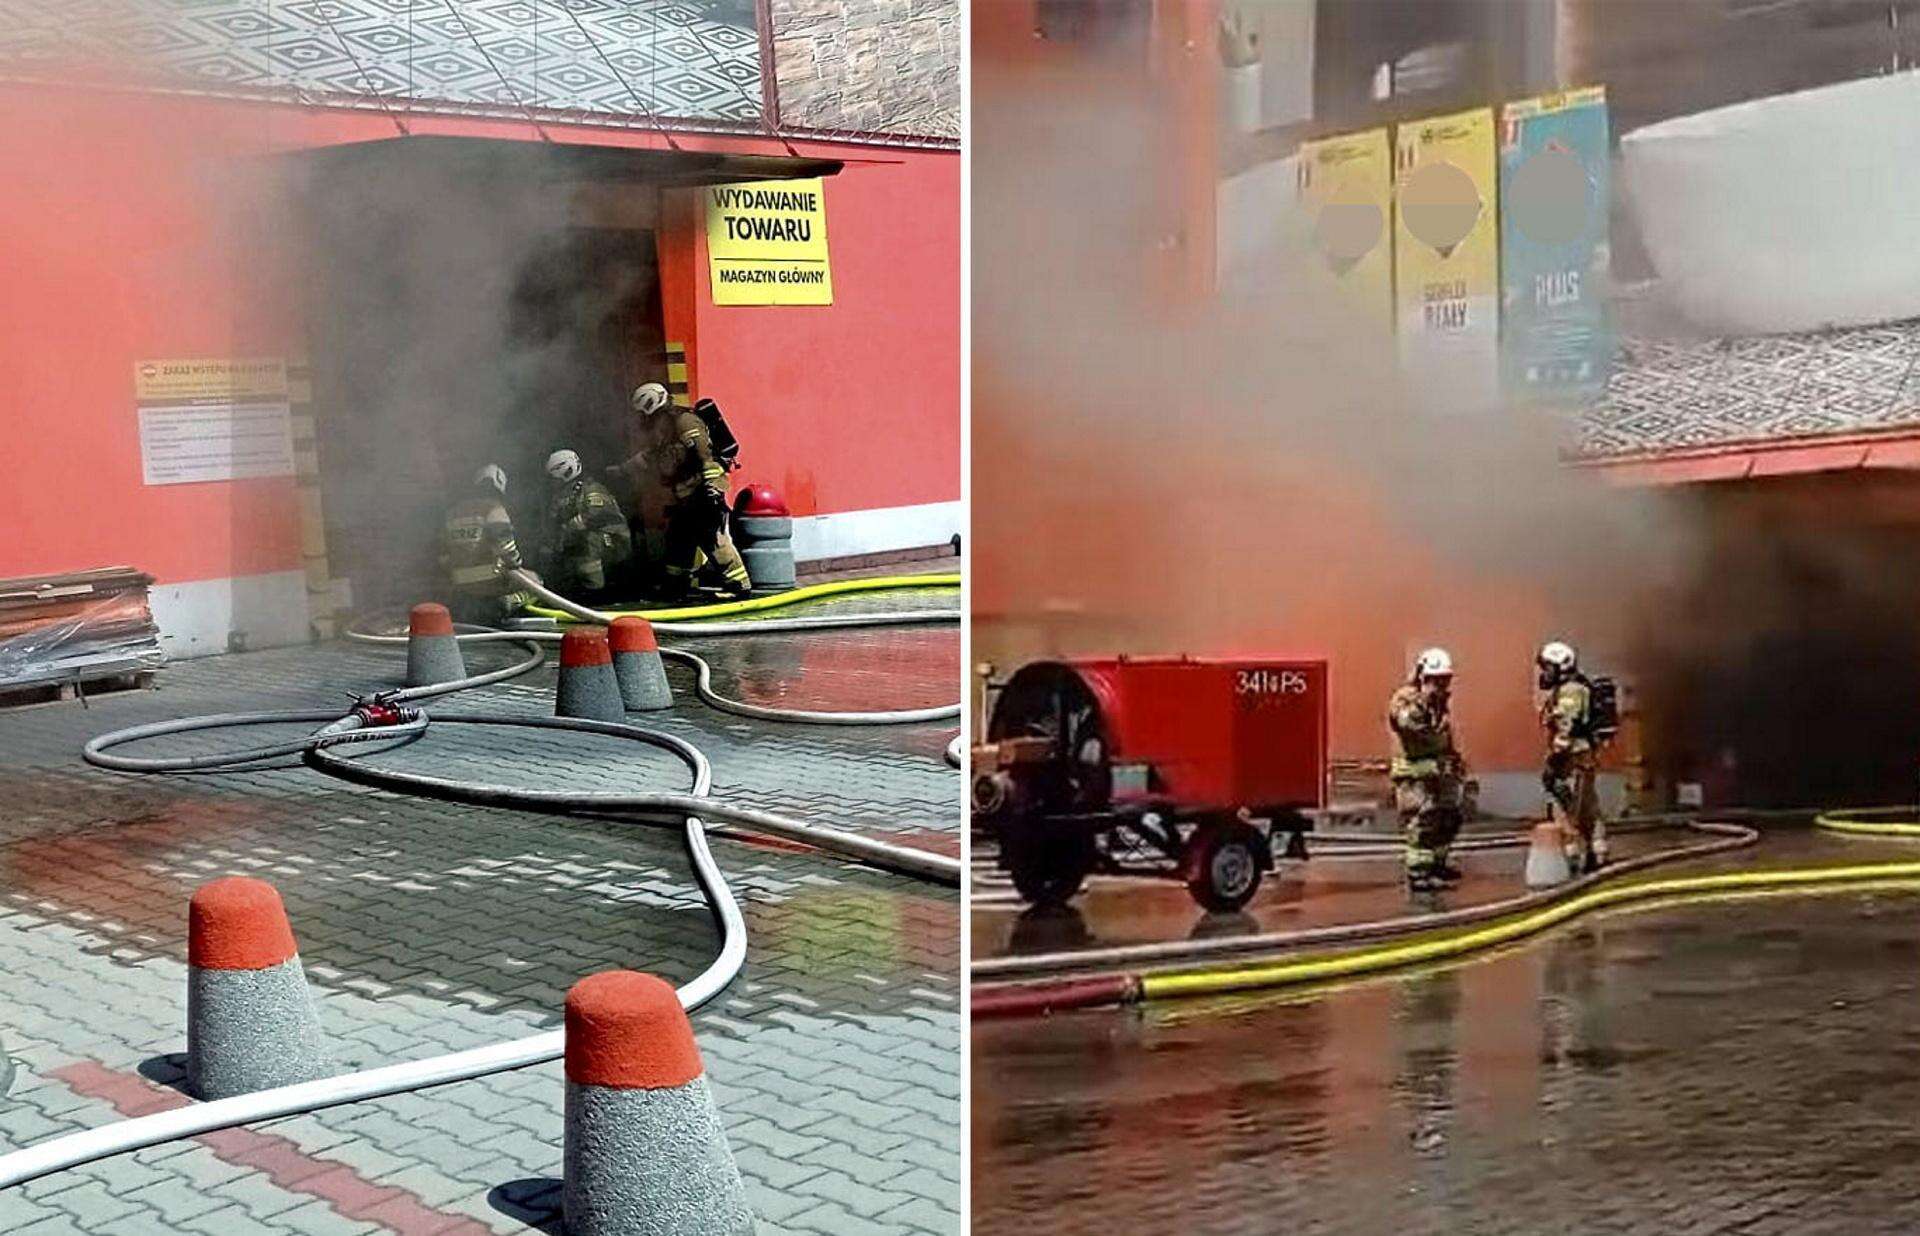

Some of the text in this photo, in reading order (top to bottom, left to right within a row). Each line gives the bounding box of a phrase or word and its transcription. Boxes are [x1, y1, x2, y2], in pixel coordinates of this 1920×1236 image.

[713, 188, 817, 212] WYDAWANIE
[725, 216, 811, 241] TOWARU
[720, 266, 825, 284] MAGAZYN GŁÓWNY
